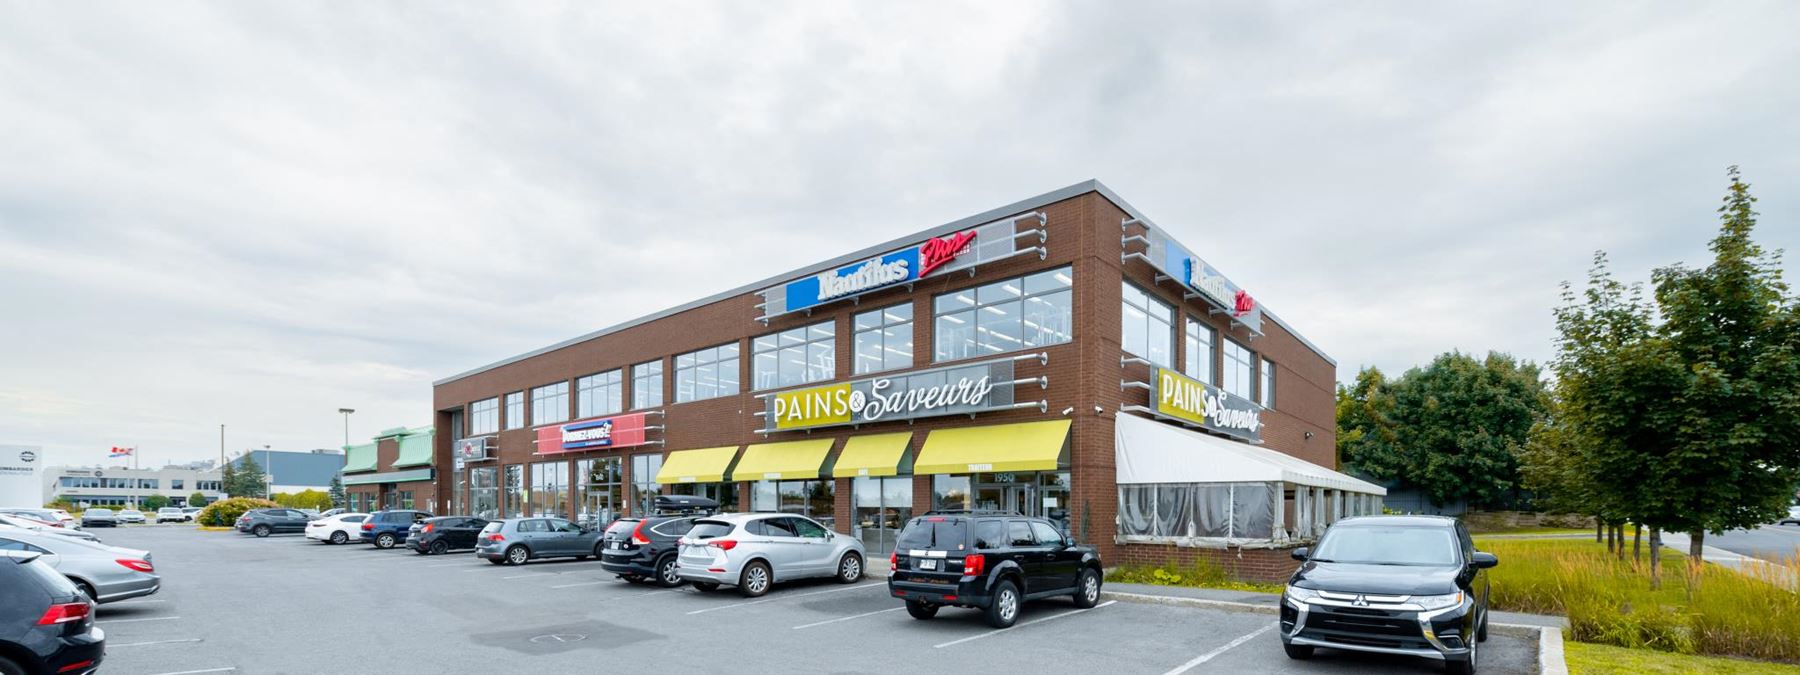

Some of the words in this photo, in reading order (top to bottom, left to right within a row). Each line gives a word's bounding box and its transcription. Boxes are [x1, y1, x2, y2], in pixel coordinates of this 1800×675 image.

[817, 256, 910, 301] Nautilus
[774, 389, 848, 423] PAINS
[850, 390, 866, 412] &
[864, 378, 993, 422] Saveurs
[1162, 374, 1209, 417] PAINS
[994, 472, 1015, 482] 1950
